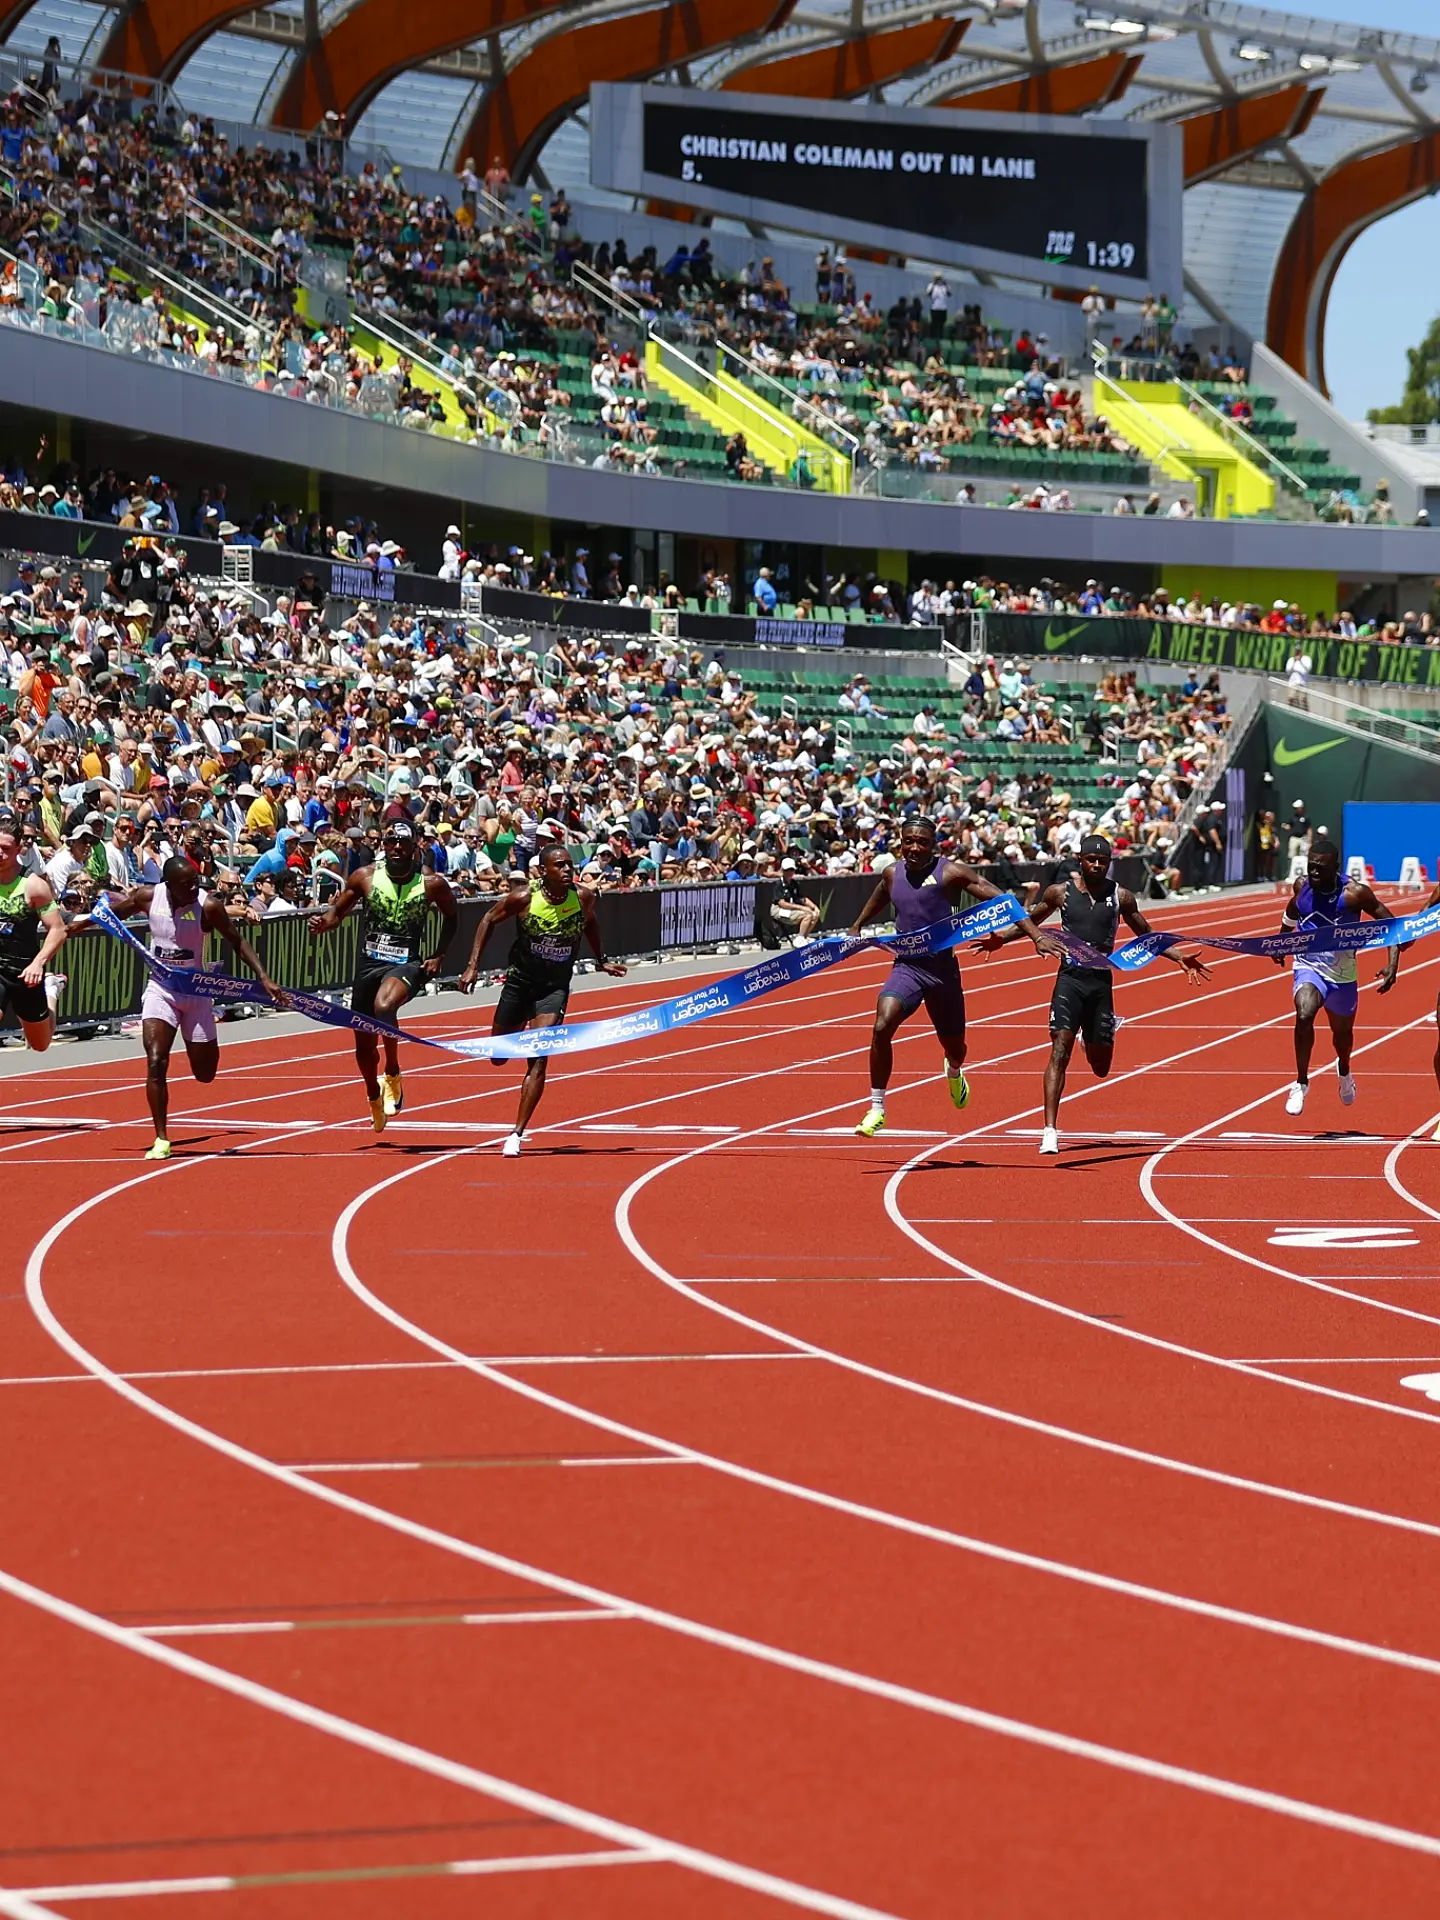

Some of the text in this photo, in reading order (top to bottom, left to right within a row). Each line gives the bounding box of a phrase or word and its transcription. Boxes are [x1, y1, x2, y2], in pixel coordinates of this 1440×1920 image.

[680, 134, 1036, 179] CHRISTIAN COLEMAN OUT IN LANE
[681, 160, 703, 182] 5.
[1045, 231, 1075, 255] PRE
[1086, 241, 1136, 268] 1:39
[1146, 623, 1163, 658] A
[1168, 623, 1230, 665] MEET
[1337, 642, 1370, 678] OF
[1378, 645, 1422, 683] THE
[951, 898, 1013, 931] Prevagen
[961, 915, 1010, 938] For Your Brain
[1261, 933, 1316, 948] Prevagen
[1333, 925, 1389, 939] Prevagen
[191, 973, 253, 991] Prevagen
[195, 986, 207, 994] For
[208, 987, 224, 996] Your
[744, 968, 791, 995] Prevagen
[672, 994, 730, 1022] Prevagen
